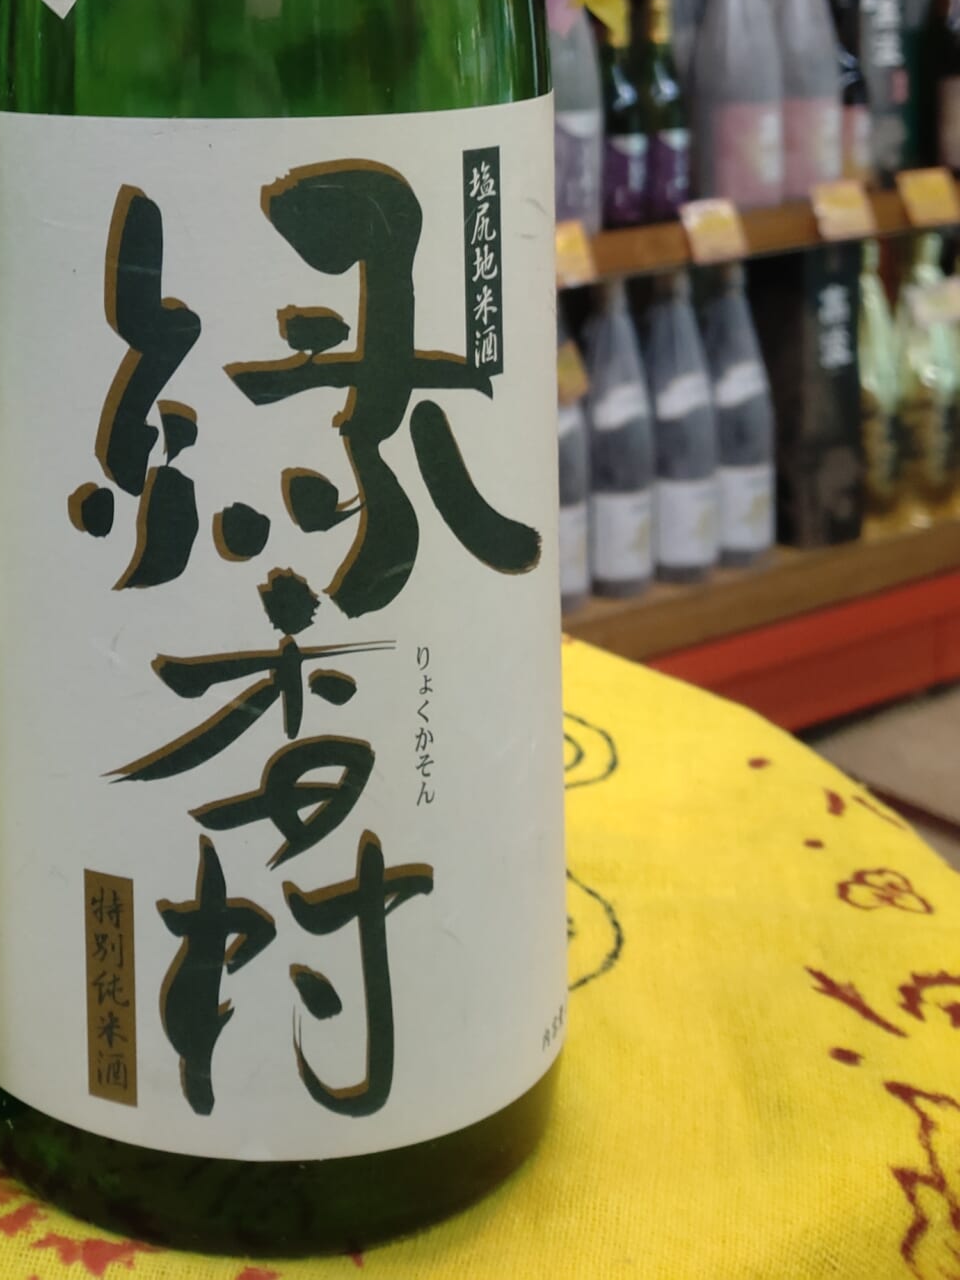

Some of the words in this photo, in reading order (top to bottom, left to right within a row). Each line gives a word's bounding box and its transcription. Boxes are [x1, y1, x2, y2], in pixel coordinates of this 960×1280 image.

[470, 161, 498, 369] 塩尻地米酒
[414, 645, 435, 807] りょくかそん
[91, 886, 129, 1091] 特別純米酒
